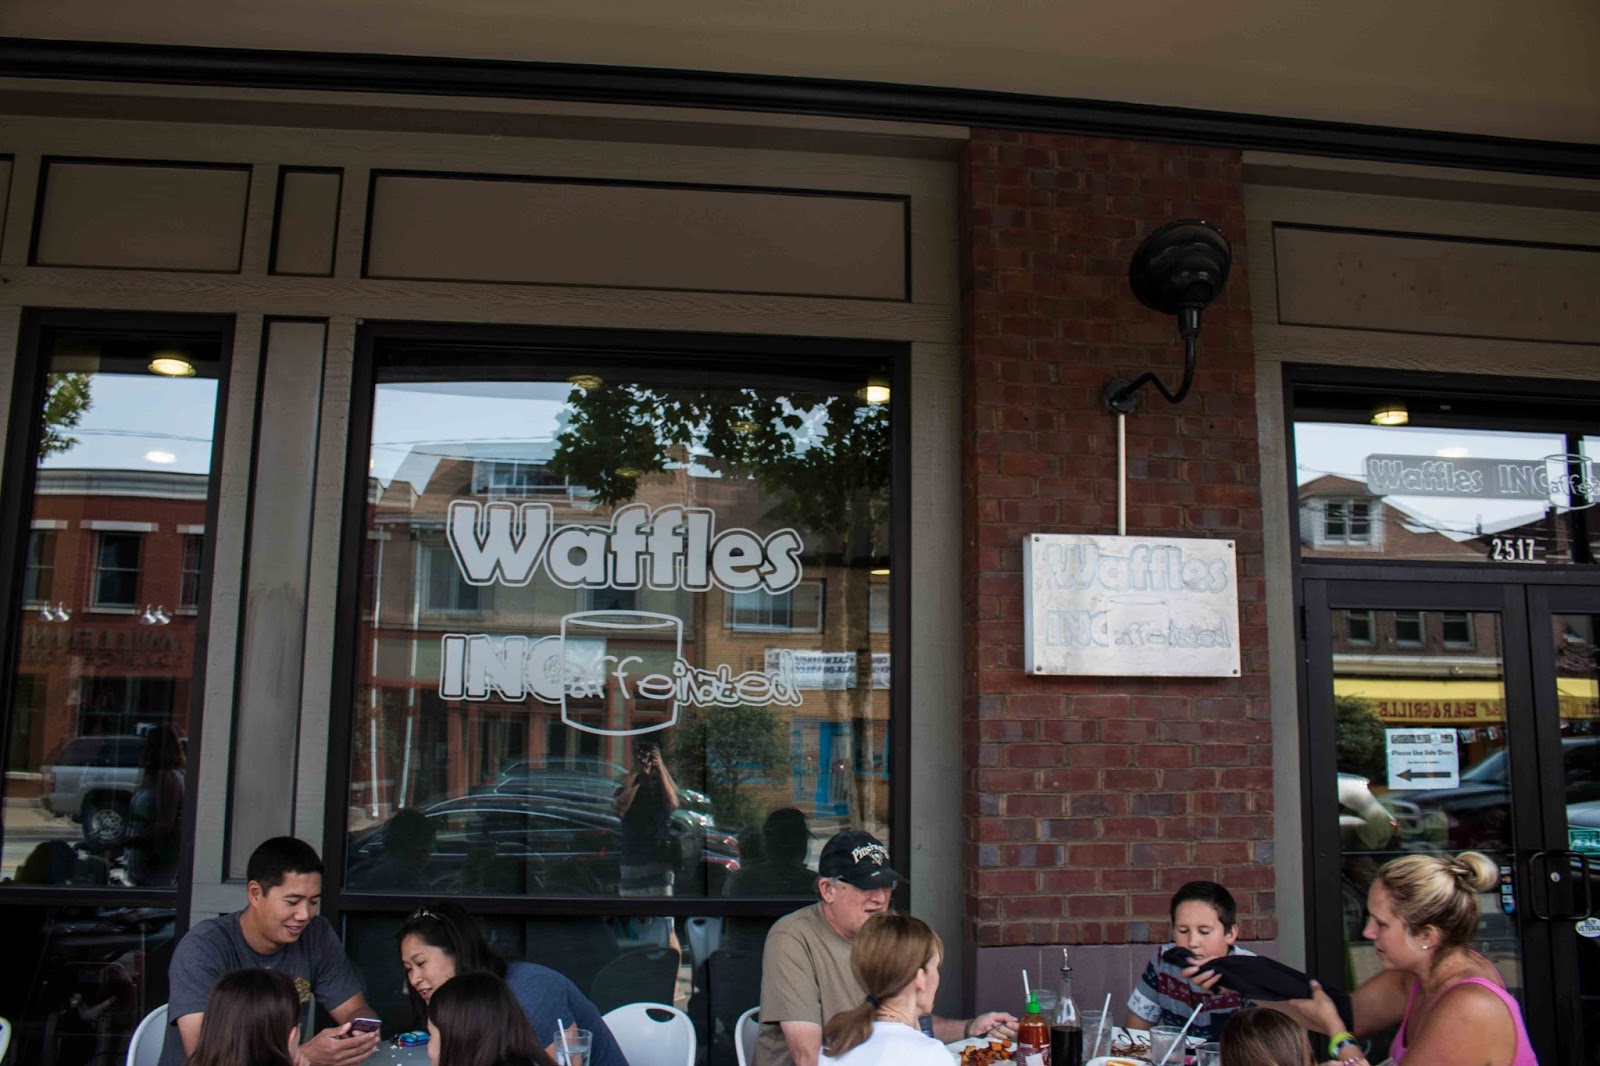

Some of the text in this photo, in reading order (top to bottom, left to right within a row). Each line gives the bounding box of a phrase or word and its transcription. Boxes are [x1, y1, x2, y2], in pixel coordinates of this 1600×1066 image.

[1370, 459, 1483, 493] Waffles
[447, 500, 804, 595] Waffles
[1492, 538, 1535, 561] 2517
[1046, 544, 1228, 593] Waffles
